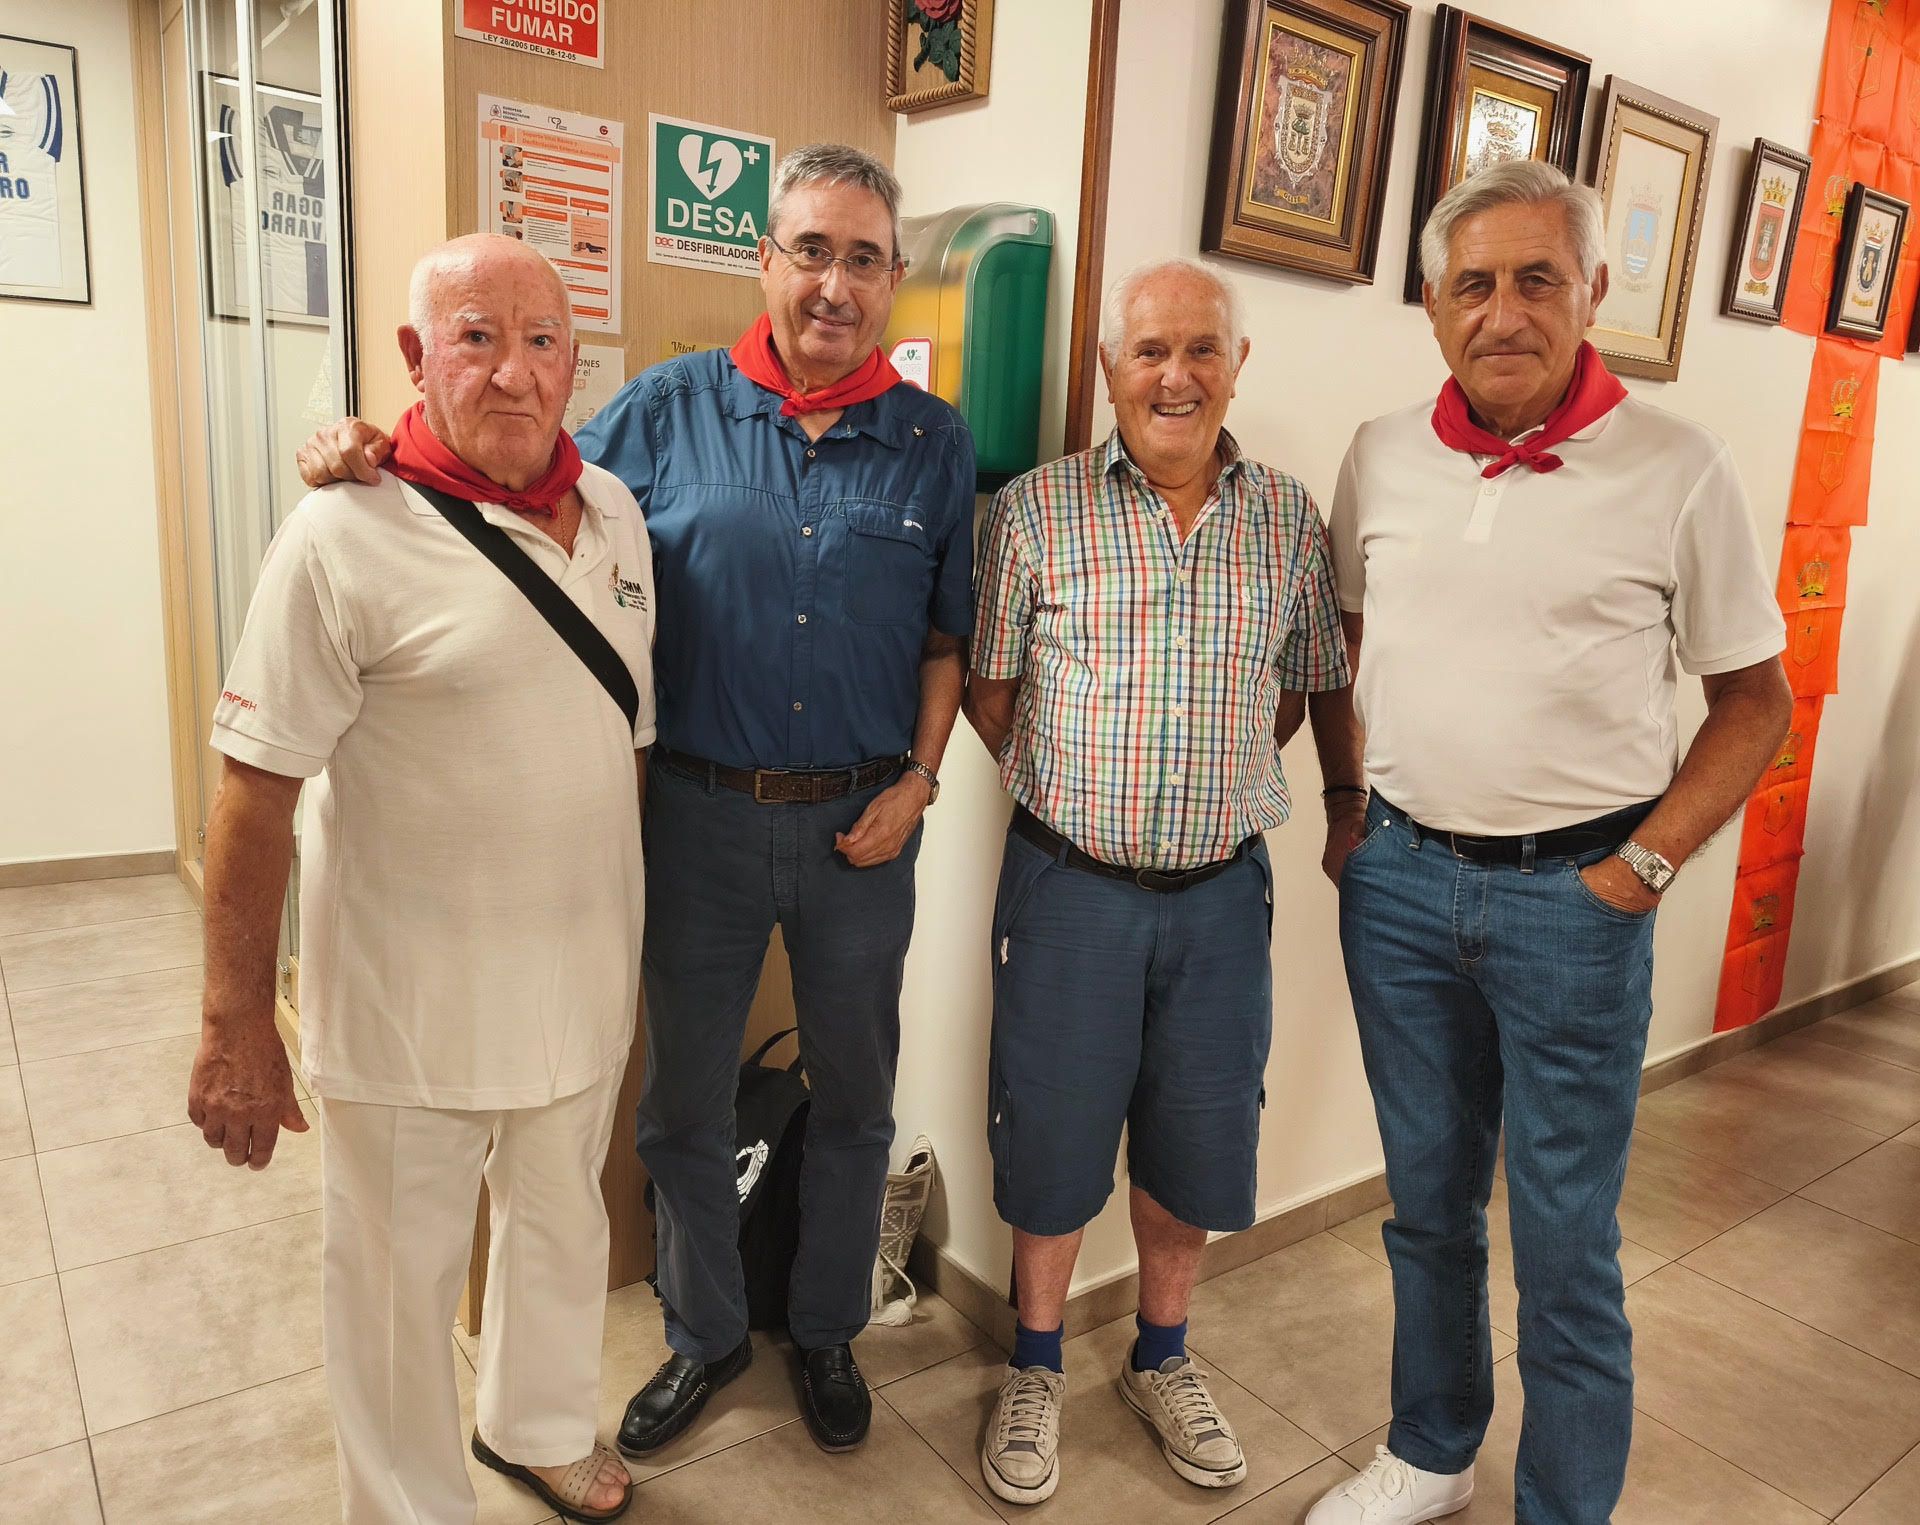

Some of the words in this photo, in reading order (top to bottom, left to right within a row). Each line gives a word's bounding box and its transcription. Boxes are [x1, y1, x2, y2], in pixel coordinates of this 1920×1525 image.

[496, 0, 596, 25] IBIDO
[491, 7, 573, 45] FUMAR
[483, 33, 498, 42] LEY
[500, 37, 528, 49] 28/2005
[530, 44, 545, 54] DEL
[667, 197, 759, 240] DESA
[677, 239, 760, 262] DESFIBRILADORE
[576, 358, 600, 368] ONES
